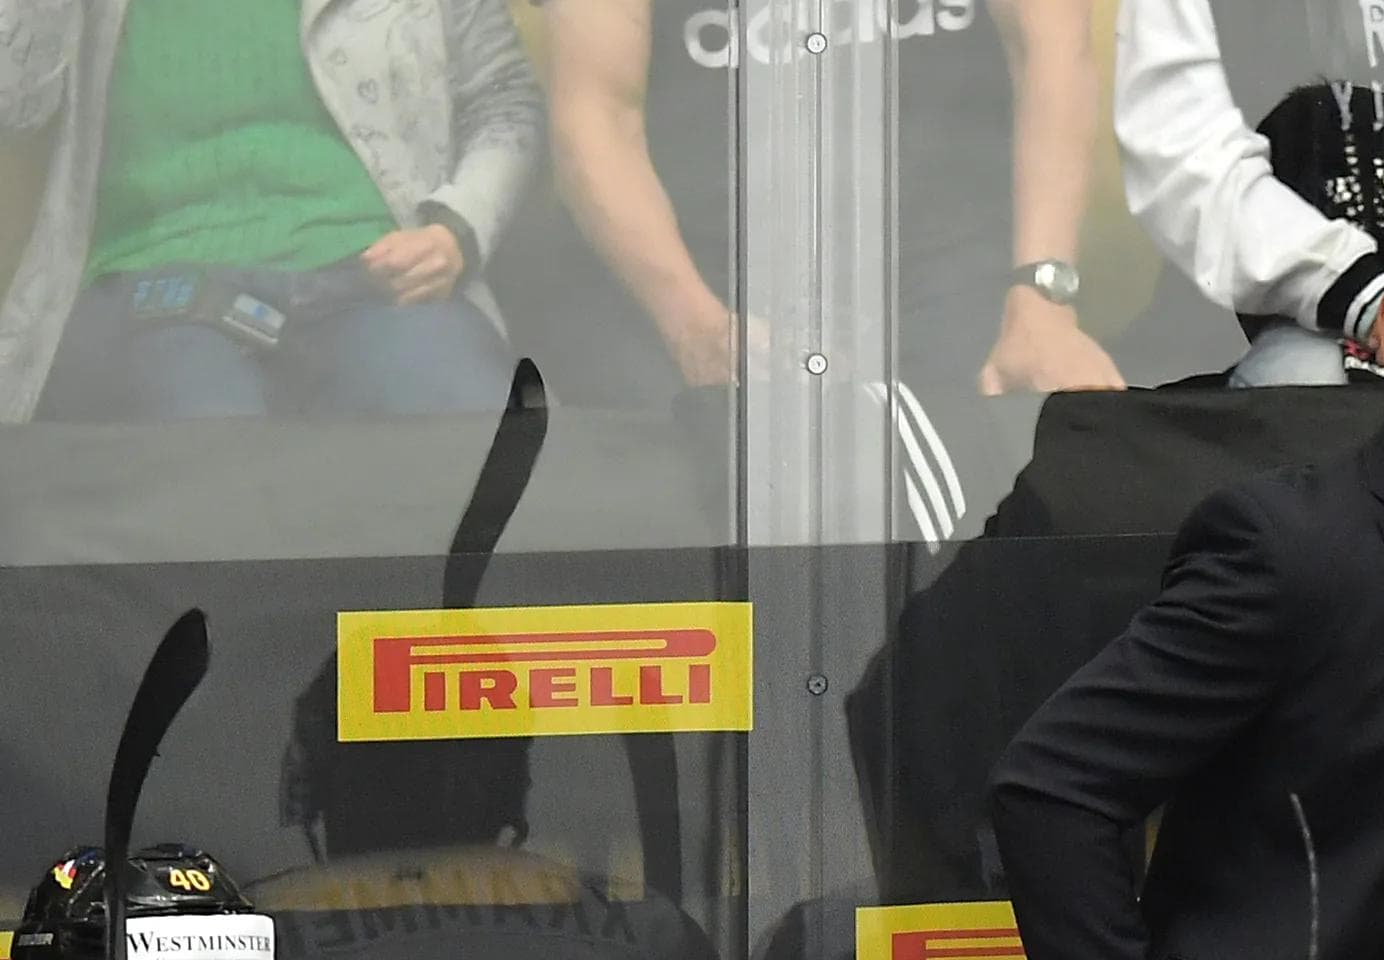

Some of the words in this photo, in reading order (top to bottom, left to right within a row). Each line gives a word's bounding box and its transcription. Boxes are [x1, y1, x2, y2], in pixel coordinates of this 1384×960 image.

[373, 629, 717, 713] PIRELLI
[169, 869, 211, 893] 40
[127, 931, 271, 953] WESTMINSTER
